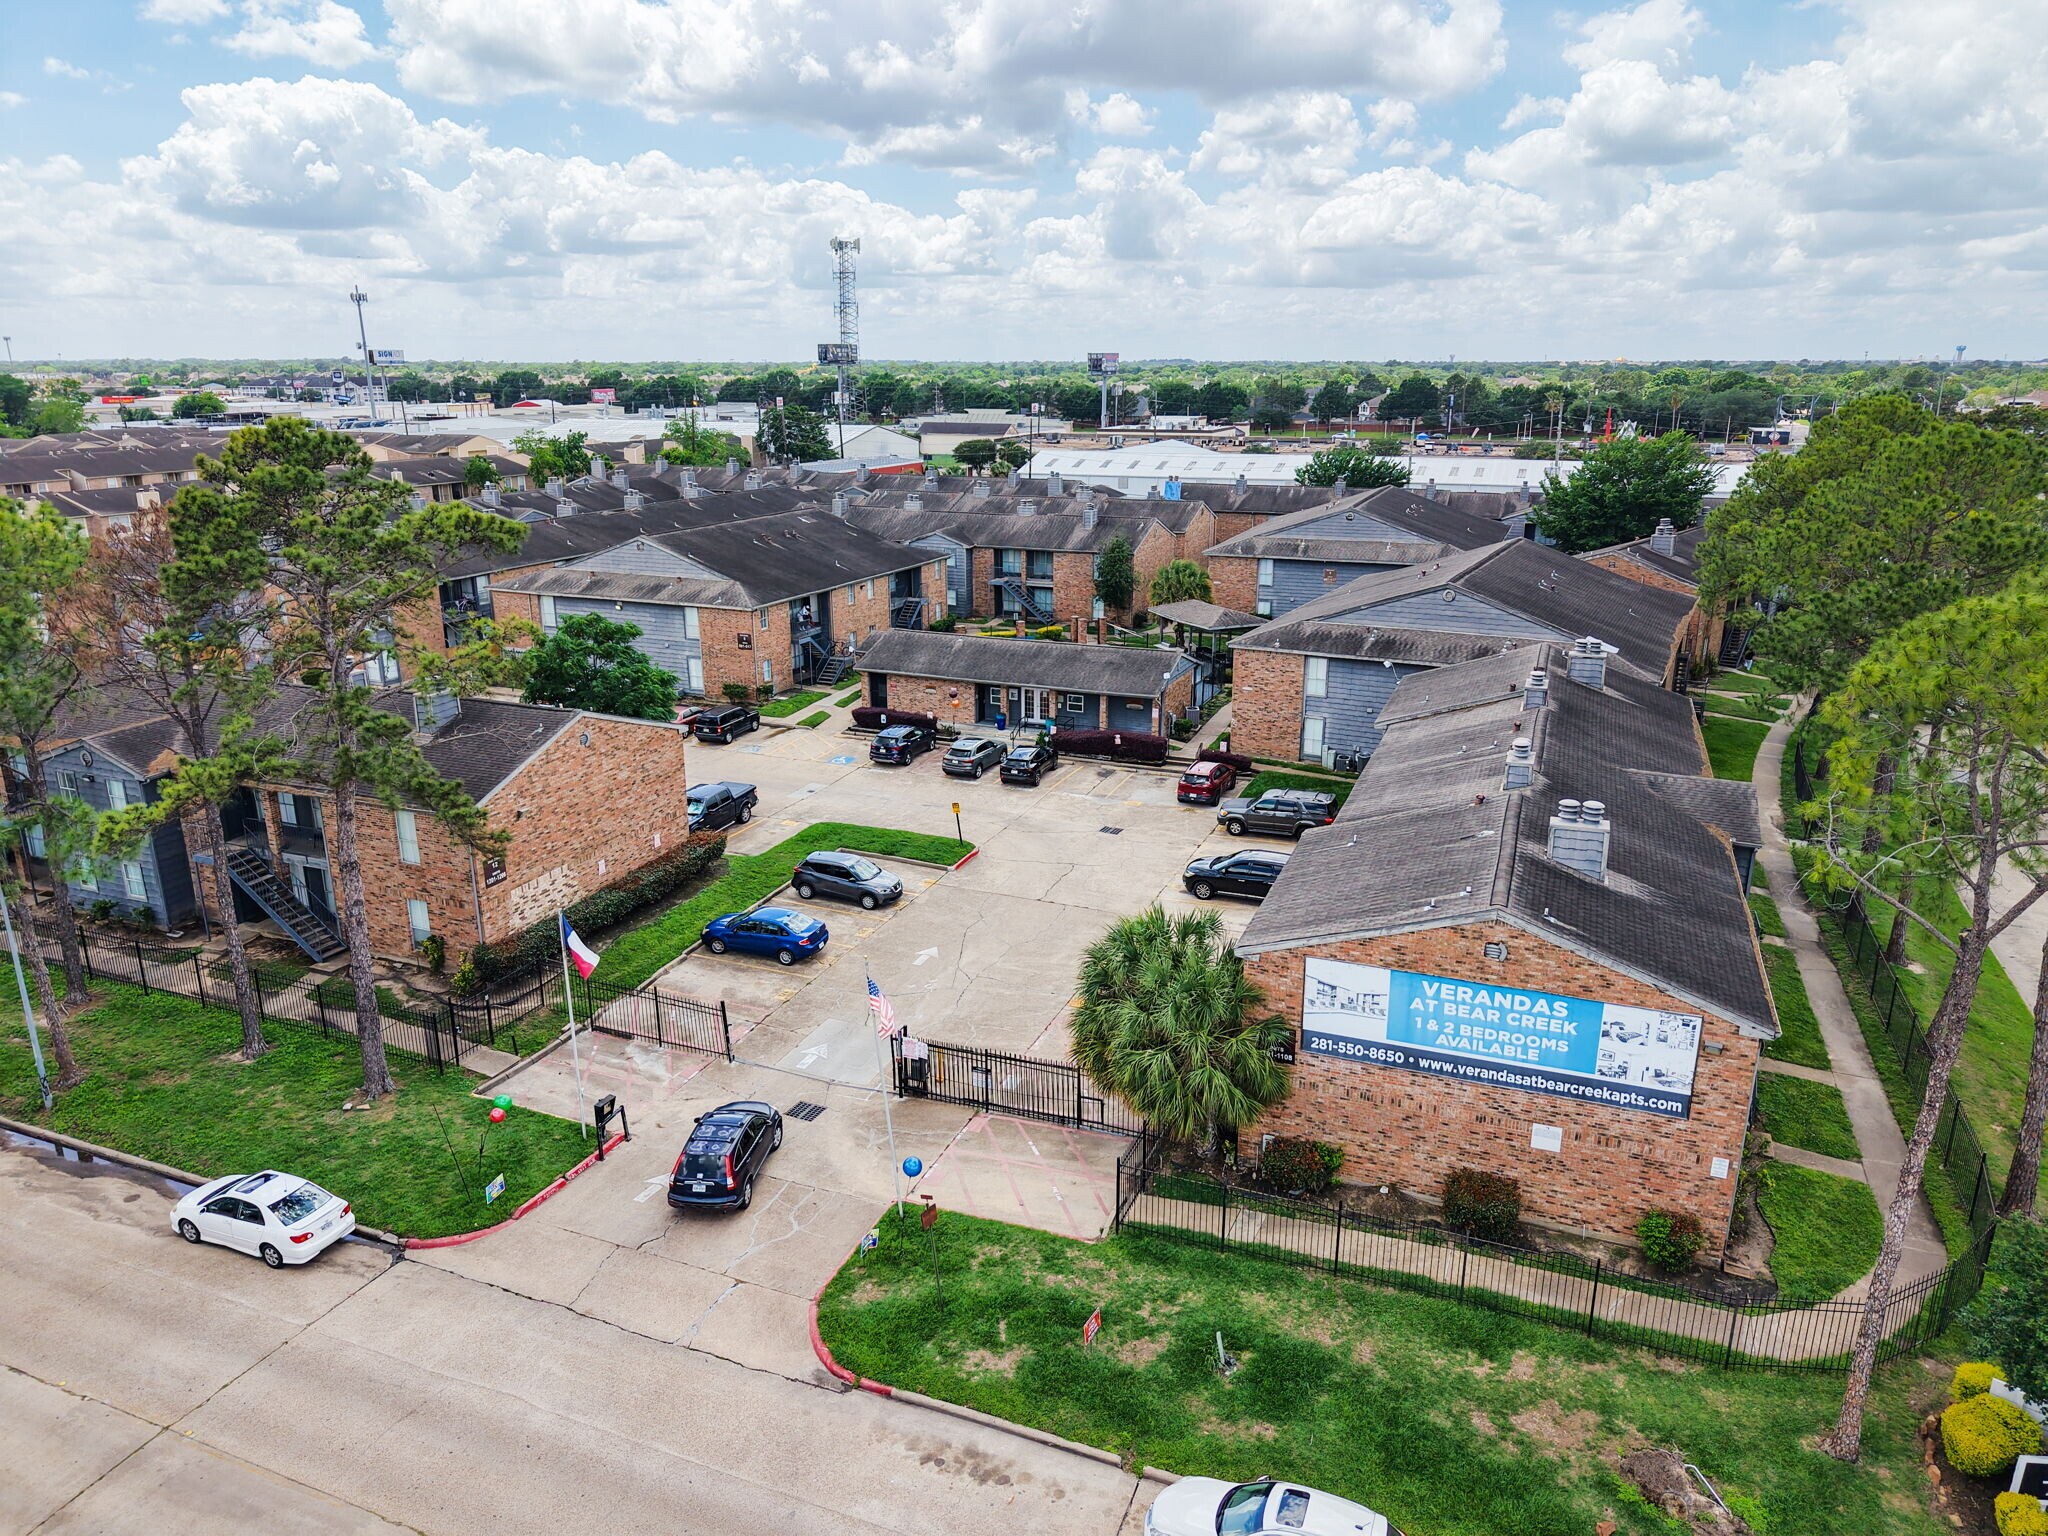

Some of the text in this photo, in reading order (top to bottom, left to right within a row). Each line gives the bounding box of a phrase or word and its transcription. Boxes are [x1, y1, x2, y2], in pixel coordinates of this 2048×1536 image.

[1409, 998, 1579, 1035] AT BEAR CREEK
[1422, 981, 1568, 1017] VERANDAS
[1415, 1017, 1569, 1052] 1 & 2 BEDROOMS
[1435, 1033, 1539, 1061] AVAILABLE
[1311, 1037, 1682, 1112] 281-550-8650 www.verandasatbearcreekapts.com
